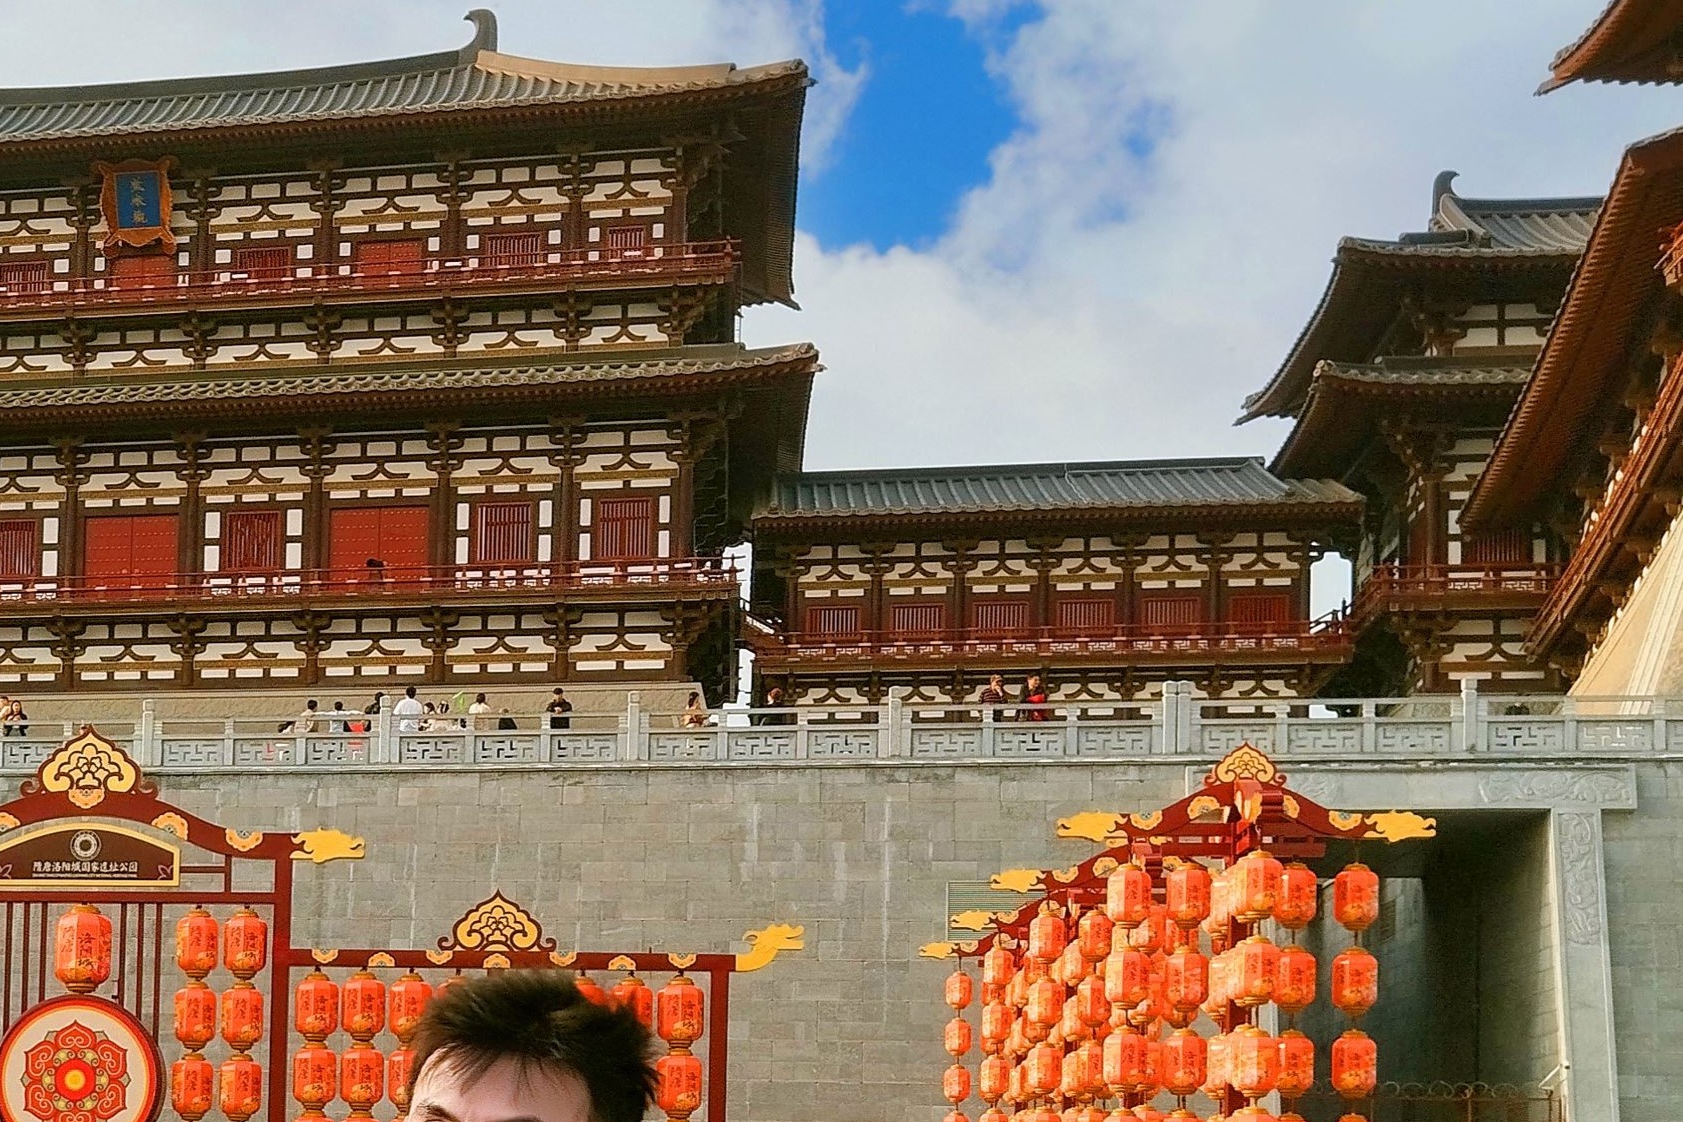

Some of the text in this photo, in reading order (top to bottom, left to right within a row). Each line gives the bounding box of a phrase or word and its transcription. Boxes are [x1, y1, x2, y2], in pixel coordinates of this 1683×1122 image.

[33, 861, 138, 873] 隋唐洛阳城国家遗址公园
[78, 932, 96, 972] 洛阳城
